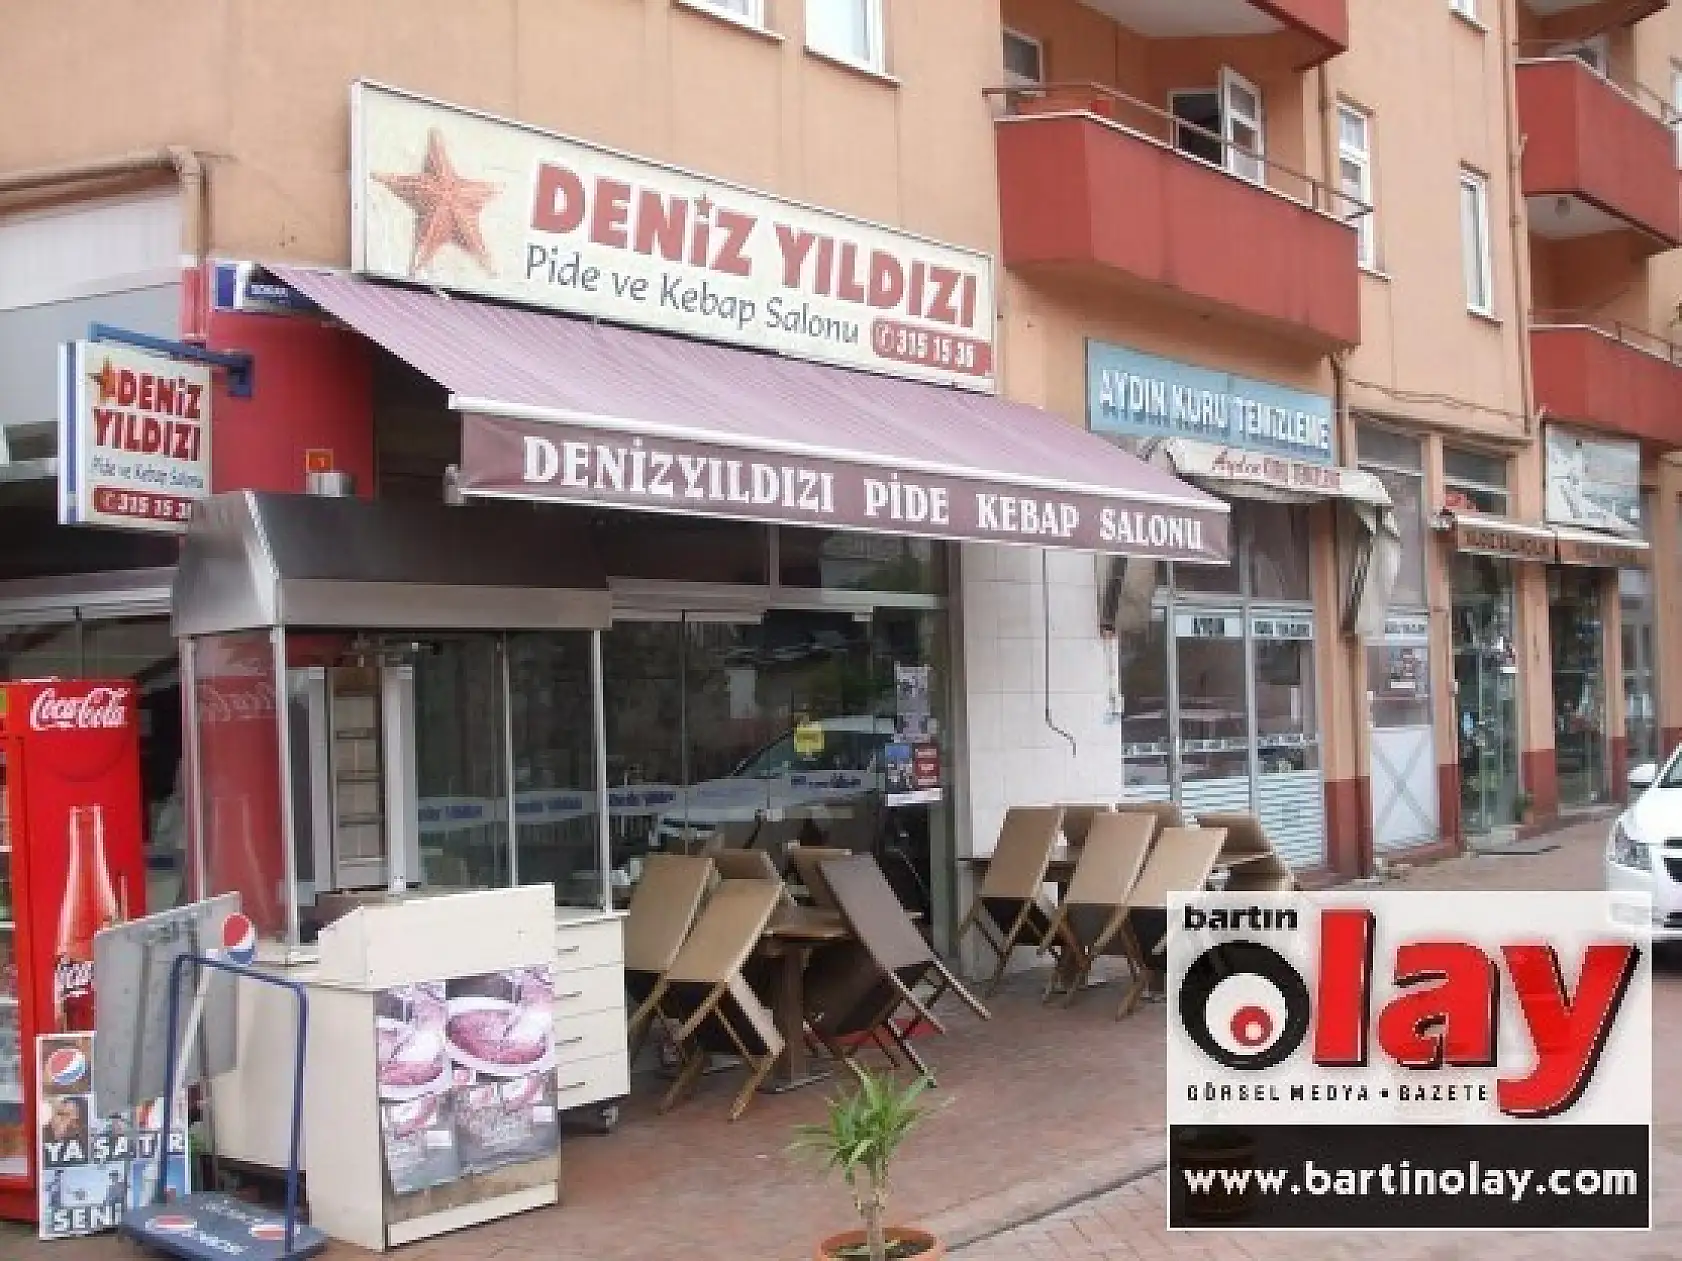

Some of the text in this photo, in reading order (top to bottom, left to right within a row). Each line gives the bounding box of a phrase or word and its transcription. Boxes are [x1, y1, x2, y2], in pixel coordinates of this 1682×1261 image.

[526, 243, 860, 346] Pide ve Kebap Salonu
[773, 223, 978, 329] YILDIZI
[896, 328, 929, 360] 315
[932, 335, 953, 365] 15
[1100, 369, 1167, 417] AYDIN
[1171, 384, 1226, 429] KURU
[93, 407, 200, 462] YILDIZI
[863, 472, 950, 526] PİDE
[975, 492, 1081, 538] KEBAP
[1099, 508, 1204, 551] SALONU
[29, 687, 131, 732] Coca-Cola
